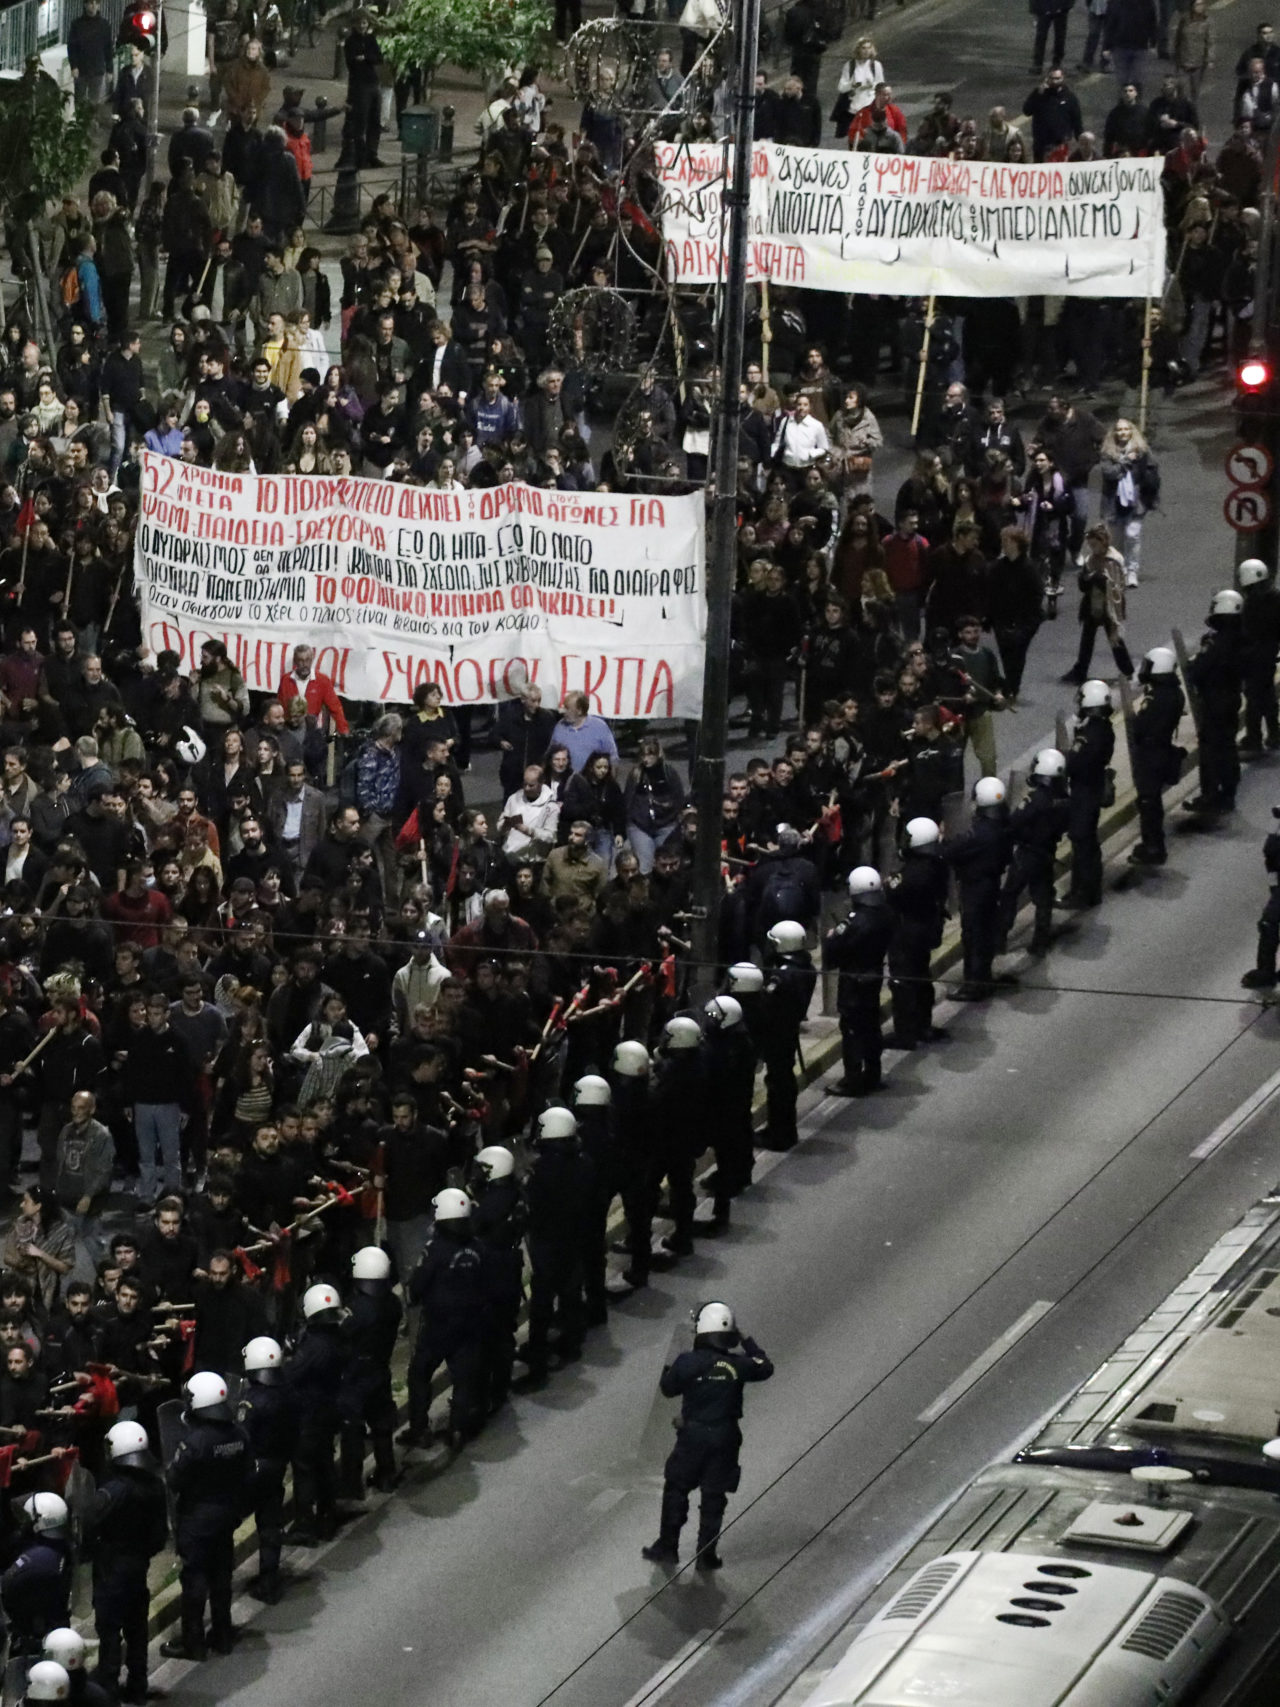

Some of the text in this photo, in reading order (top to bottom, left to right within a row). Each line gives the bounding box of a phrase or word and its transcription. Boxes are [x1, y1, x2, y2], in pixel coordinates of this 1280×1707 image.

[779, 153, 850, 190] αγώνες
[980, 203, 1122, 242] ΙΜΠΕΡΙΑΛΙΣΜΟ
[143, 451, 175, 499] 52
[180, 463, 243, 495] ΧΡΟΝΙΑ
[178, 483, 233, 512] ΜΕΤΑ
[253, 476, 279, 514] ΤΟ
[398, 488, 462, 522] ΔΕΙΧΝΕΙ
[630, 498, 666, 528] ΓΙΑ
[141, 524, 150, 552] Ο
[152, 529, 250, 576] ΑΥΤΑΡΧΙΣΜΟΣ
[396, 559, 418, 589] ΣΤΑ
[422, 562, 471, 591] ΣΧΕΔΙΑ
[475, 559, 501, 591] ΤΗΣ
[588, 567, 610, 596] ΓΙΑ
[613, 564, 699, 597] ΔΙΑΓΡΑΦΕΣ
[429, 531, 445, 562] ΟΙ
[528, 525, 547, 557] ΤΟ
[551, 531, 593, 565] ΝΑΤΟ
[205, 574, 306, 603] ΠΑΝΕΠΙΣΤΗΜΙΑ
[314, 573, 337, 605] ΤΟ
[510, 584, 534, 610] ΘΑ
[558, 654, 675, 718] ΕΚΠΑ
